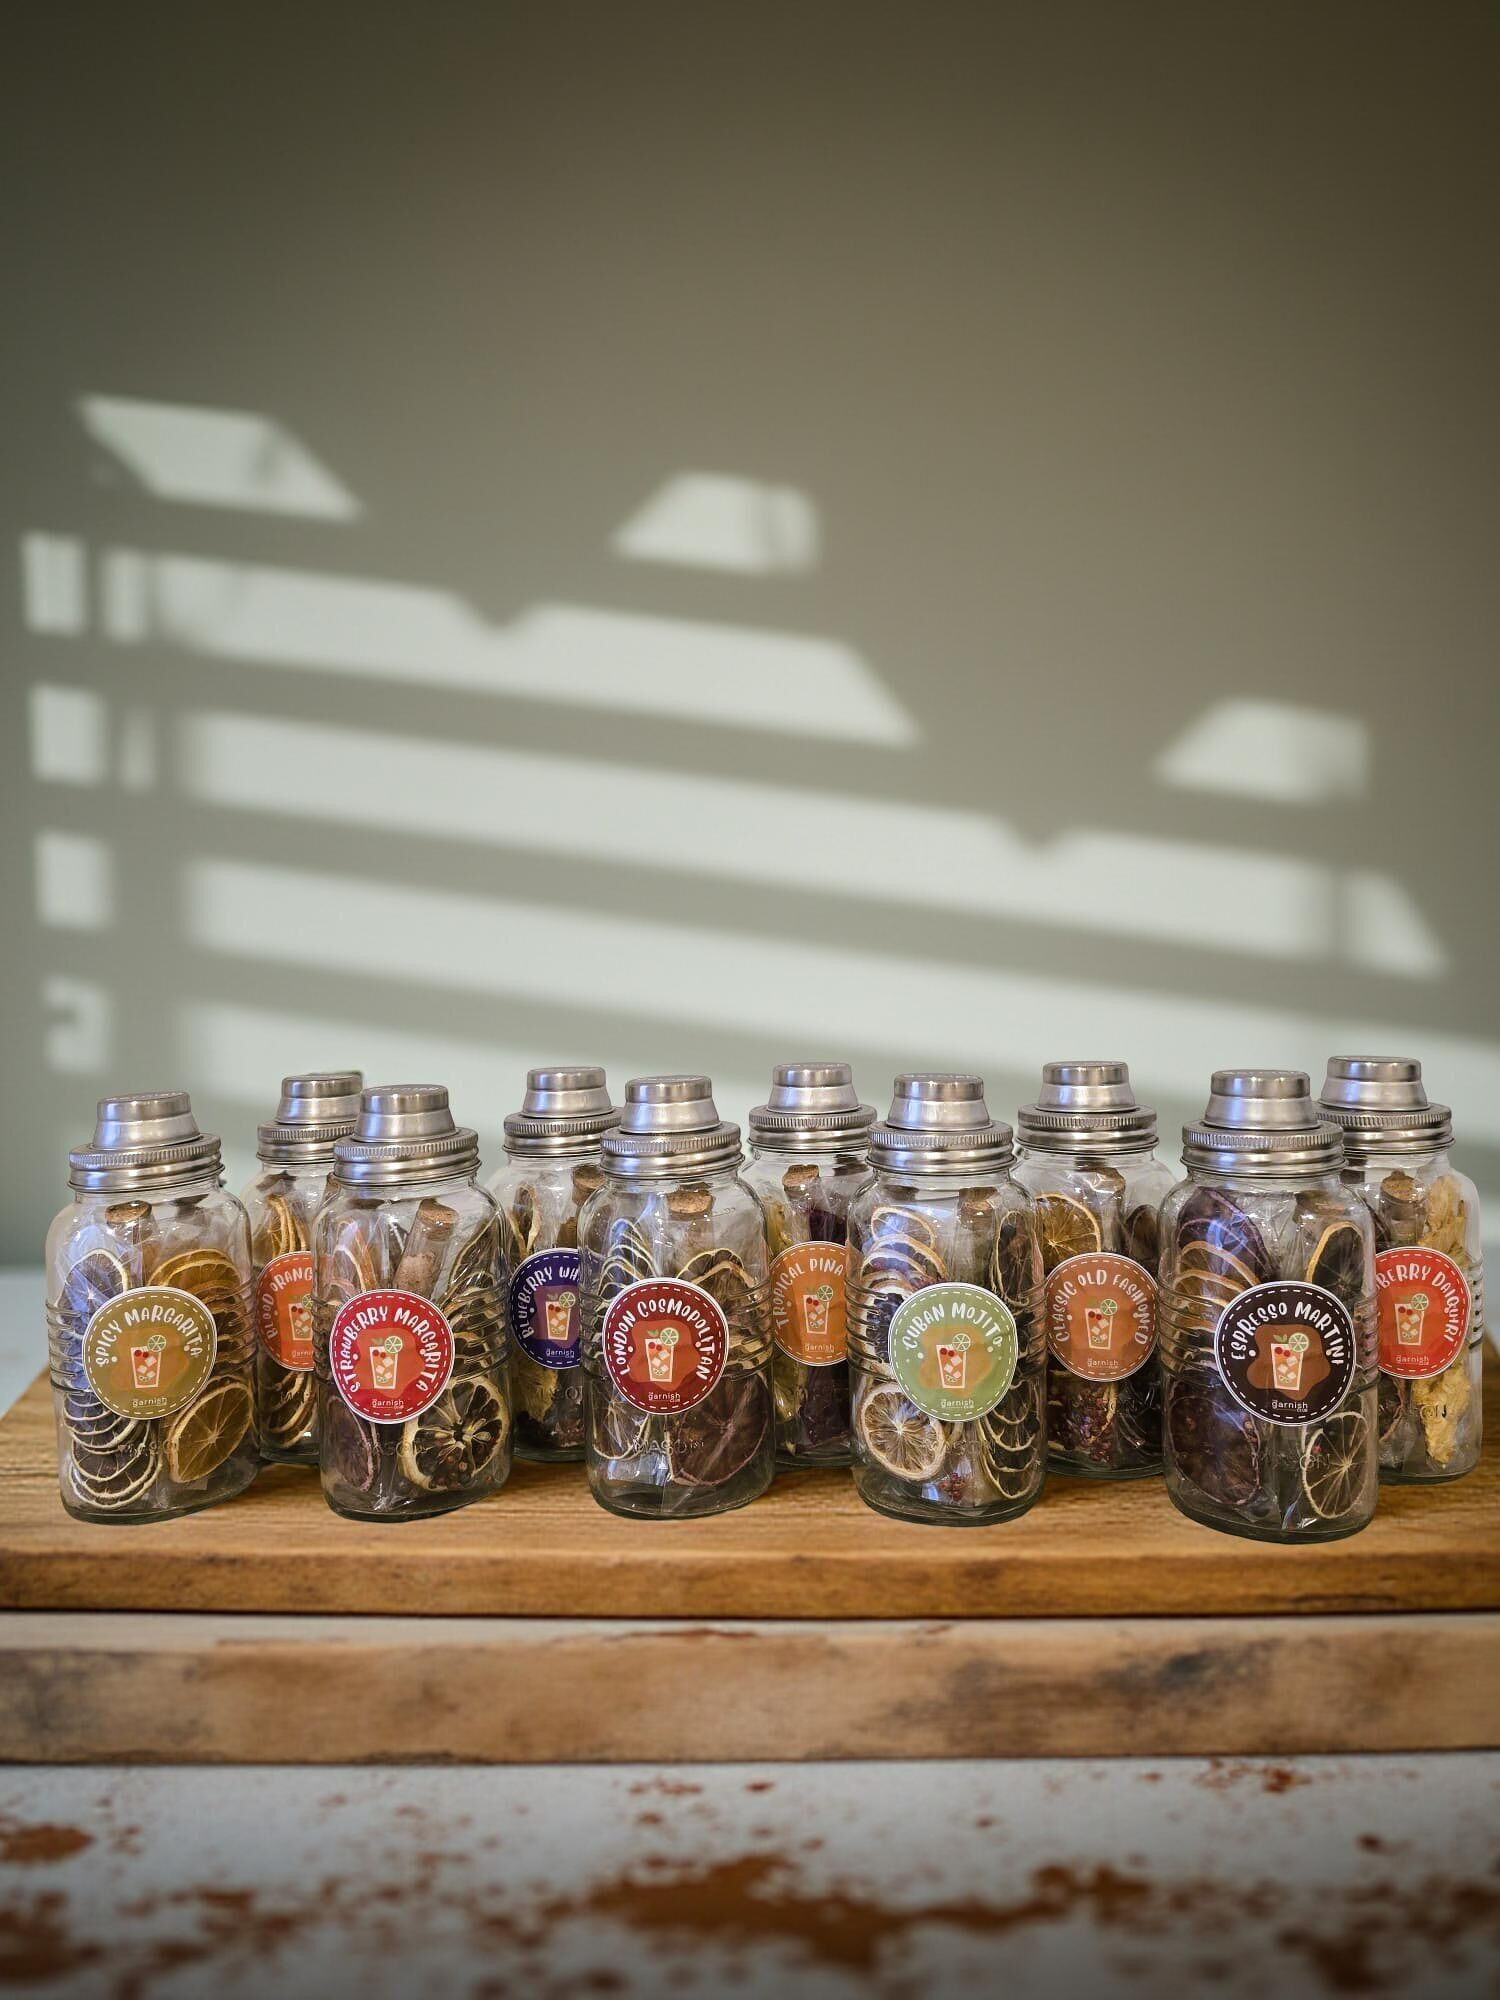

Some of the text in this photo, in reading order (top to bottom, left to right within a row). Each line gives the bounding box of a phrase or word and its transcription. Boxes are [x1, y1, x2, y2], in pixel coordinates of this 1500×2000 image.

[262, 1267, 312, 1339] BLOOD ORANG
[517, 1266, 579, 1339] BLUEBERRY WH
[772, 1258, 844, 1329] TROPICAL PINA
[1376, 1262, 1431, 1289] BERRY
[902, 1302, 1003, 1349] CUBAN MOJITO
[1052, 1269, 1151, 1345] CLASSIC OLD FASHIONED
[1231, 1301, 1344, 1364] ESPRESSO MARTINI
[95, 1304, 203, 1367] SPICY MARGARITA
[291, 1350, 313, 1358] garni
[340, 1305, 441, 1392] STRAWBERRY MARGARITA
[546, 1348, 575, 1357] garnish
[613, 1298, 715, 1380] LONDON COSMOPOLITAN
[372, 1399, 404, 1408] garnish
[648, 1392, 681, 1400] garnish
[941, 1398, 974, 1409] garnish
[1271, 1400, 1308, 1409] garnish
